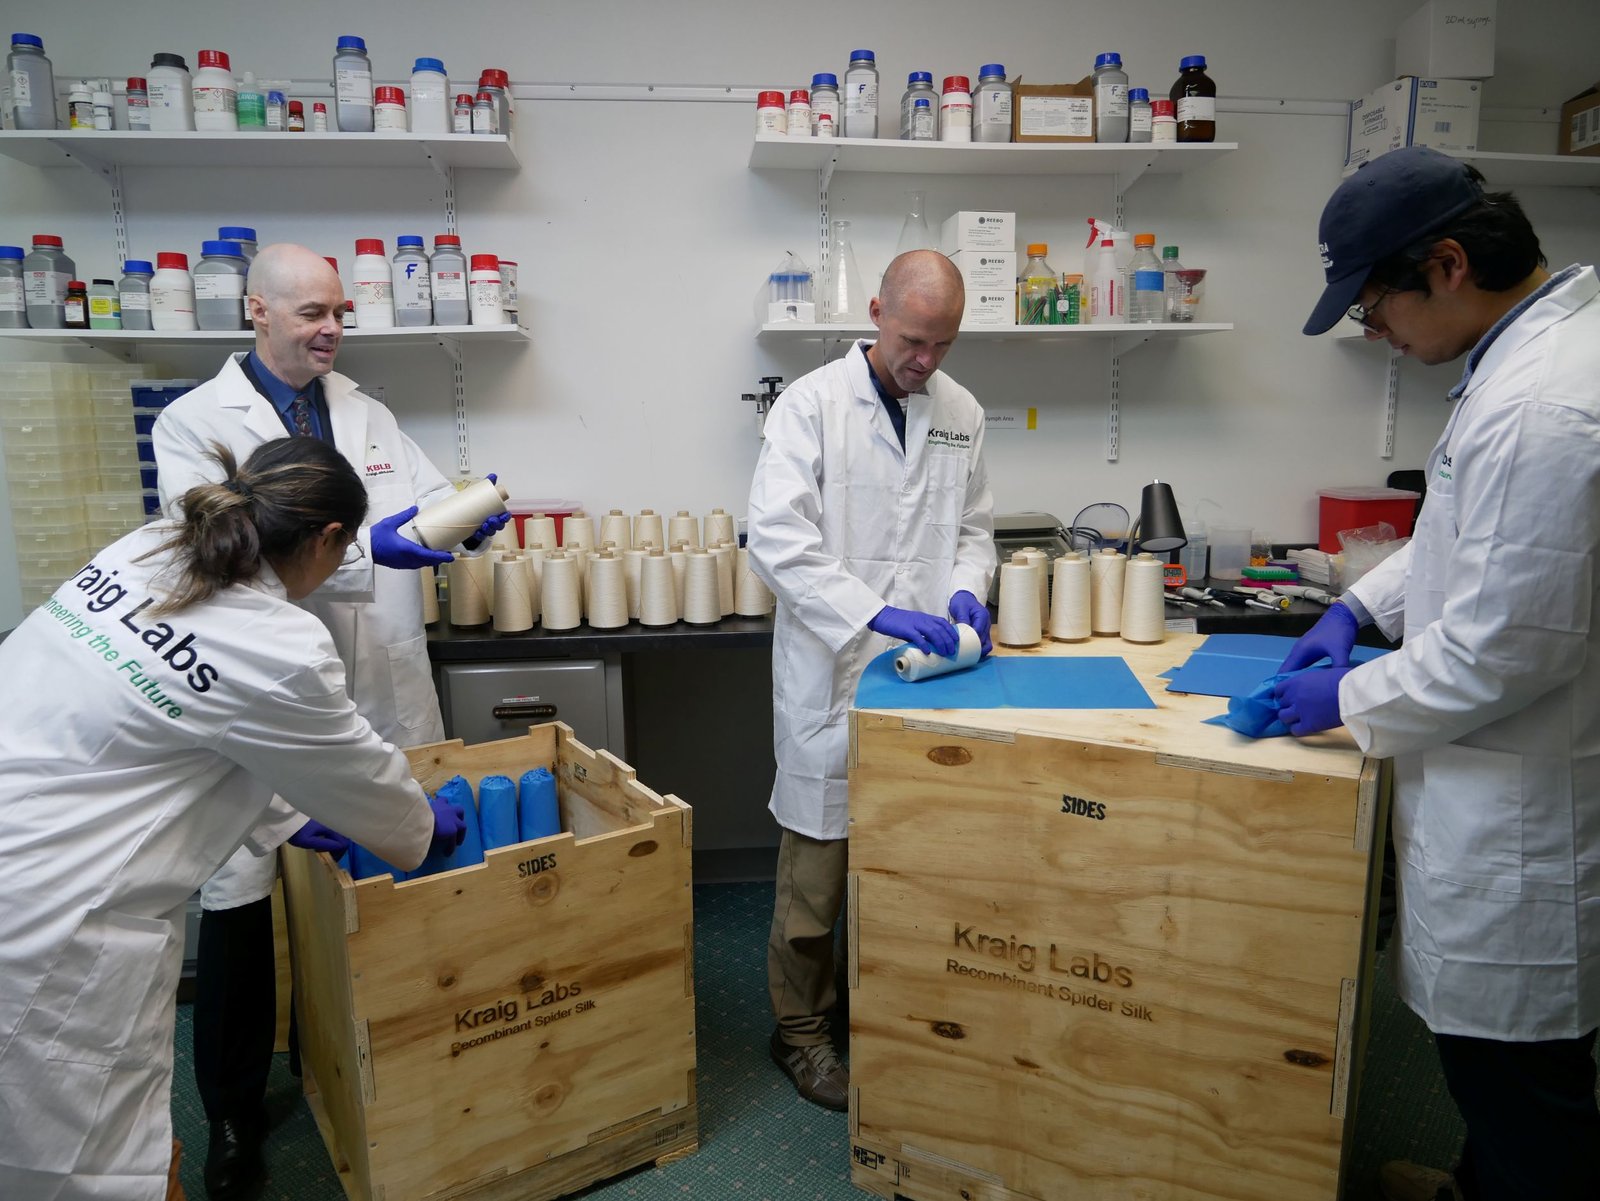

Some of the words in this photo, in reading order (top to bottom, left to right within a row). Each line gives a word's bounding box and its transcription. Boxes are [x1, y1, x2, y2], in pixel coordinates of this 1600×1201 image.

[405, 263, 418, 280] F
[928, 428, 949, 441] Kraig
[950, 431, 970, 442] Labs
[366, 463, 391, 472] KBLB
[69, 563, 128, 613] raig
[120, 597, 218, 693] Labs
[43, 595, 94, 639] neering
[88, 634, 119, 661] the
[116, 659, 183, 719] Future
[1060, 794, 1106, 820] SIDES
[517, 853, 557, 878] SIDES
[954, 922, 1036, 972] Kraig
[1050, 943, 1133, 988] Labs
[454, 999, 518, 1034] Kraig
[526, 981, 582, 1012] Labs
[946, 958, 1054, 998] Recombinant
[1058, 986, 1113, 1012] Spider
[1120, 1001, 1153, 1022] Silk
[450, 1020, 532, 1053] Recombinant
[534, 1007, 573, 1028] Spider
[575, 999, 597, 1014] Silk
